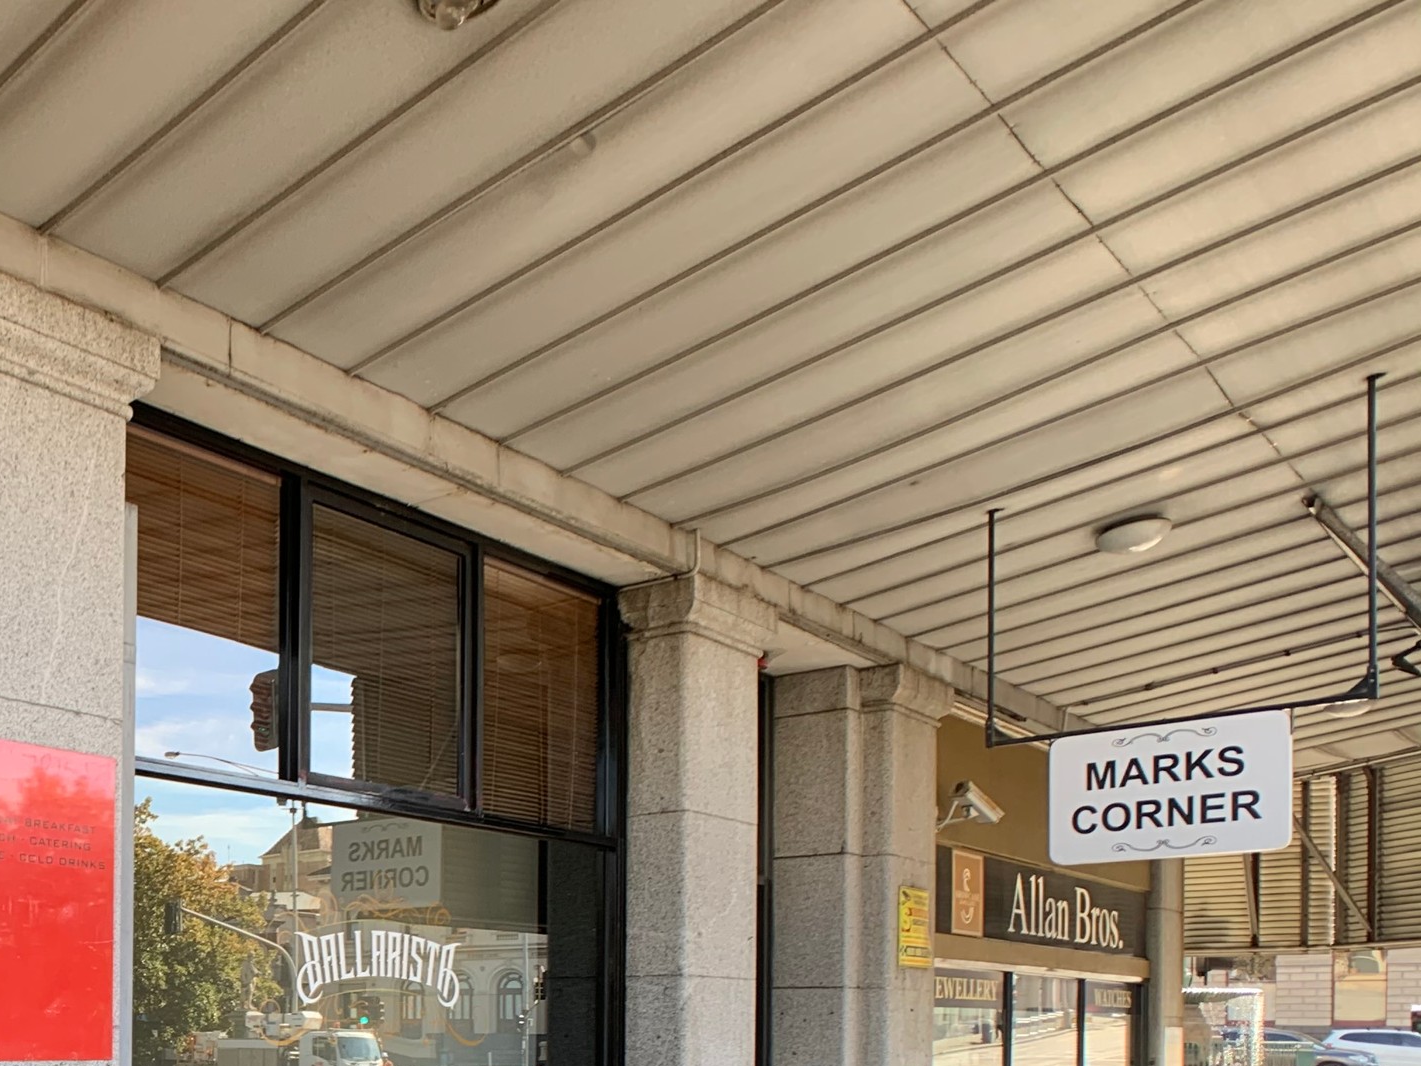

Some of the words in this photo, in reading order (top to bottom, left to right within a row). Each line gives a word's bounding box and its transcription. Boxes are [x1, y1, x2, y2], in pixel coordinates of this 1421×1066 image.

[1086, 746, 1245, 791] MARKS
[25, 818, 97, 835] BREAKFAST
[1072, 790, 1262, 834] CORNER
[29, 836, 91, 851] CATERING
[59, 858, 106, 870] DRINKS
[1007, 872, 1070, 941] Allan
[1074, 886, 1124, 949] Bros.
[294, 930, 462, 1009] BALLARISTA
[935, 976, 998, 1001] EWELLERY
[1094, 989, 1132, 1008] WATCHES
